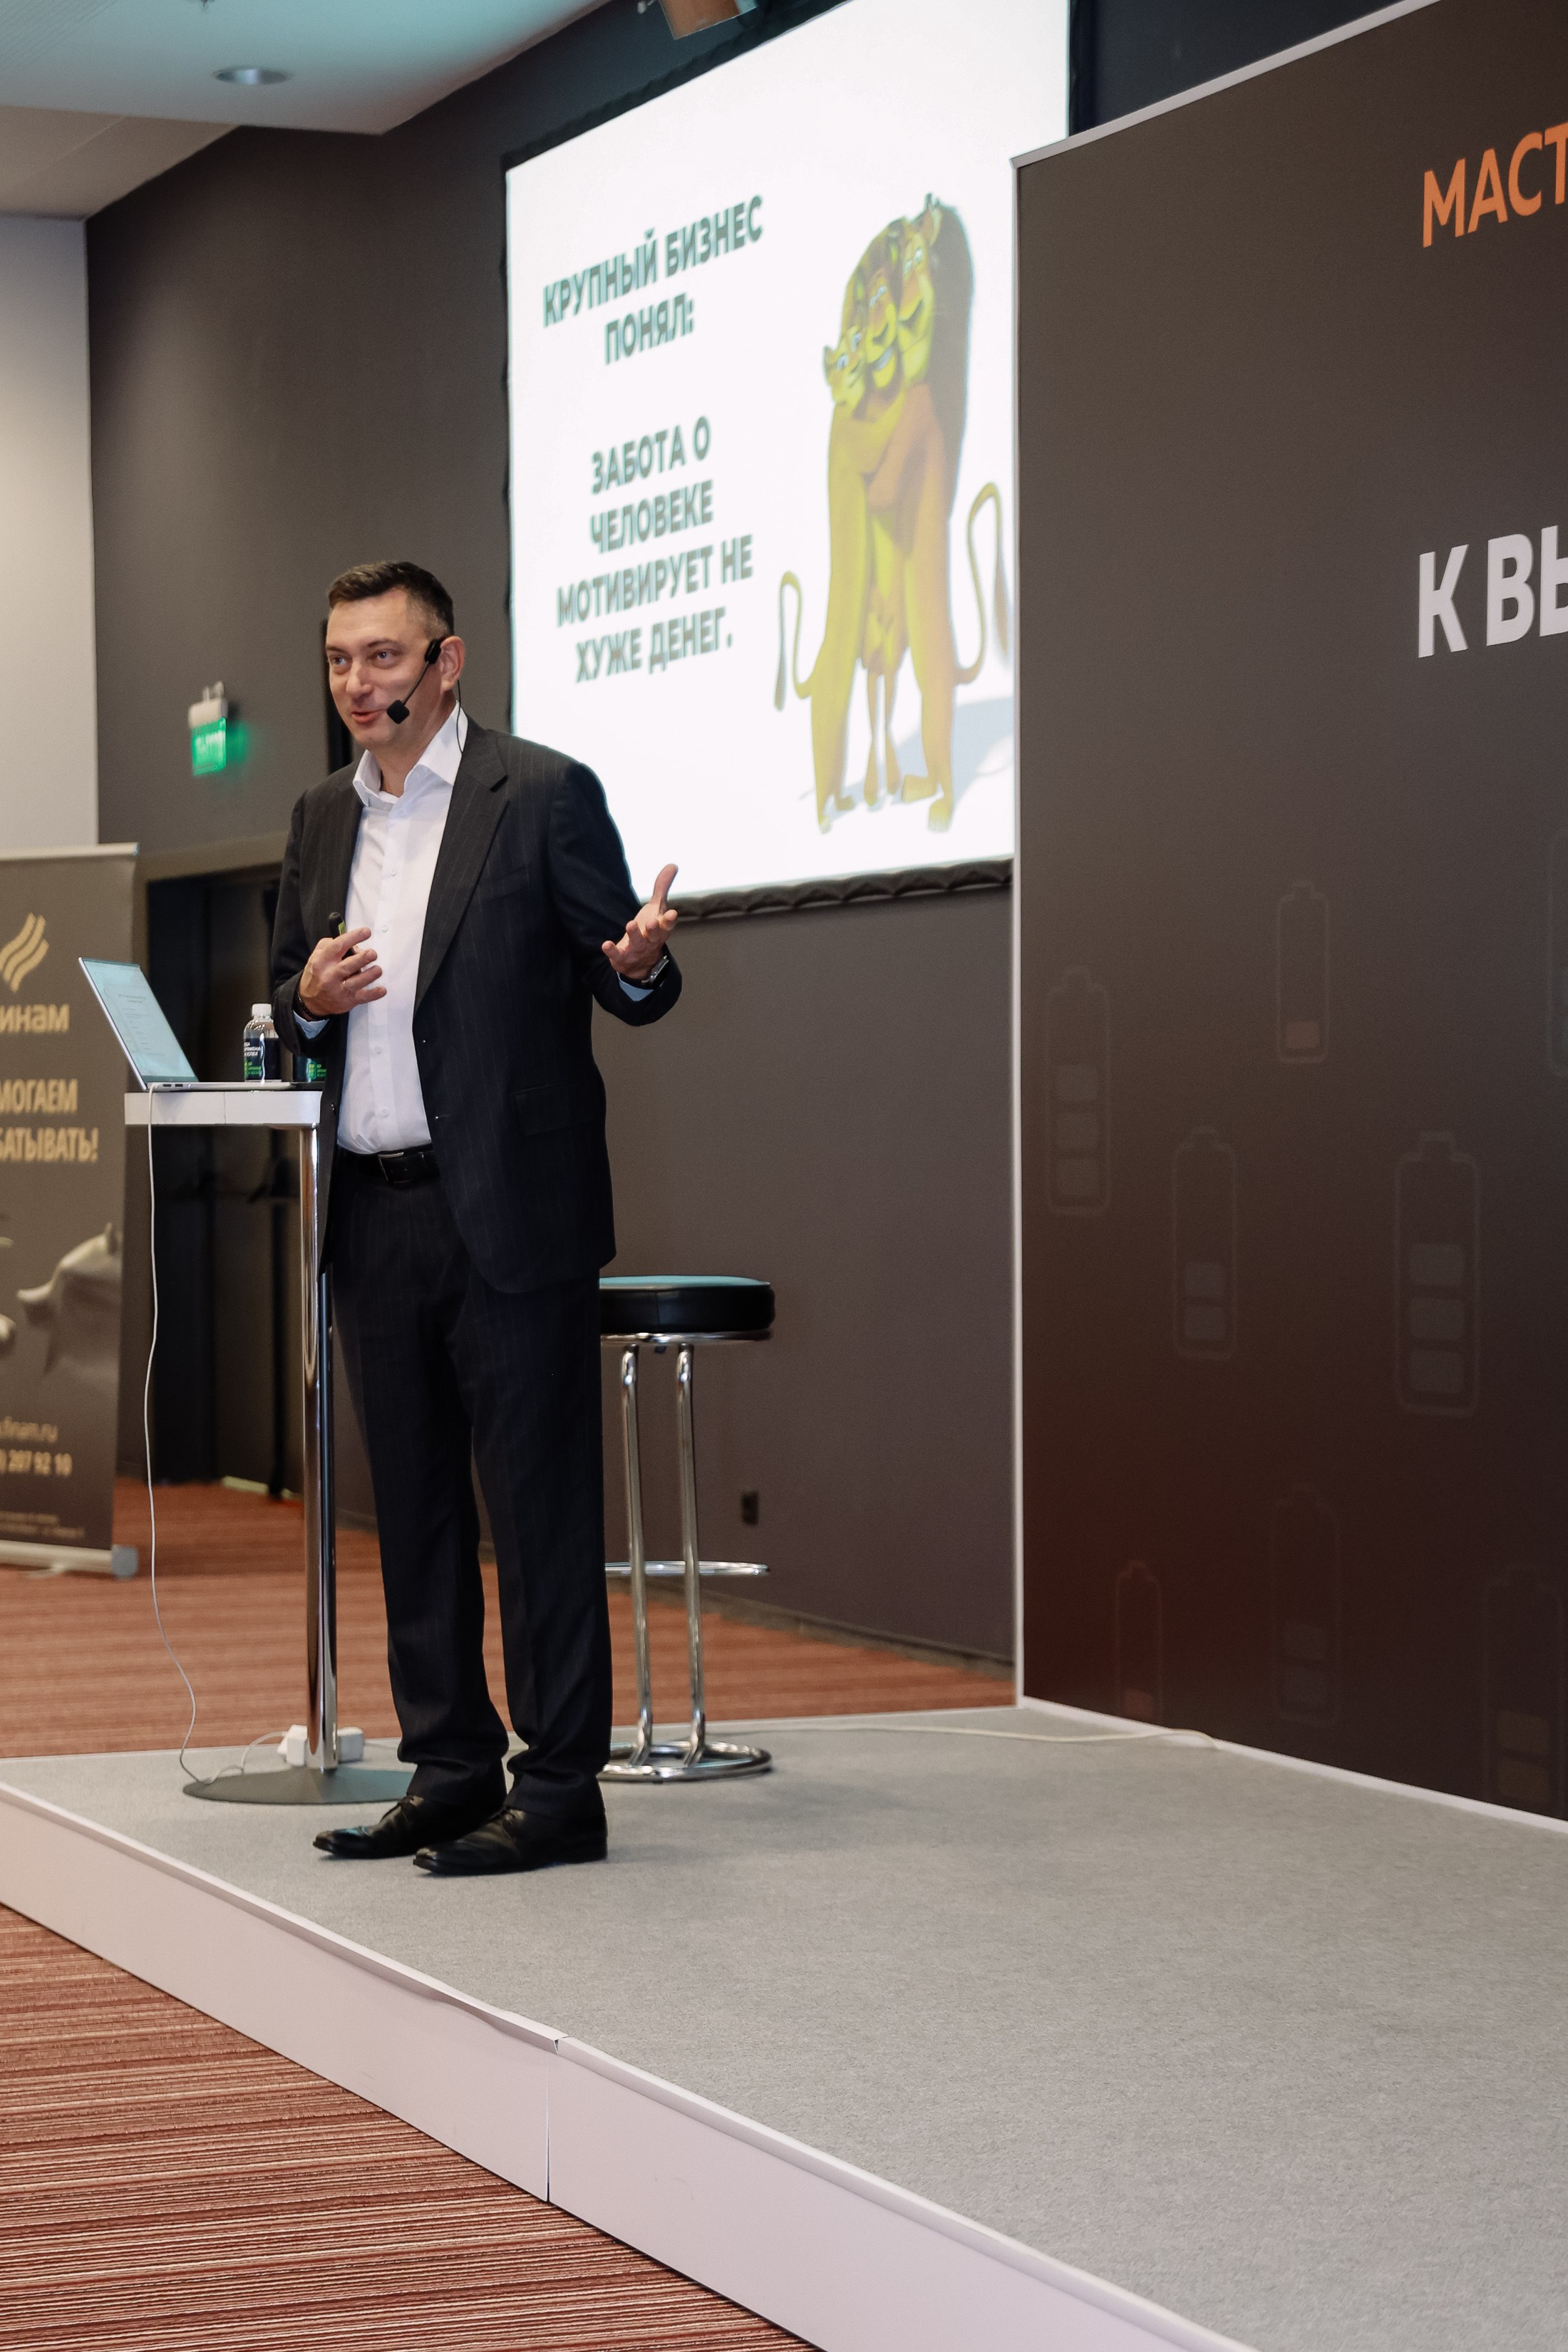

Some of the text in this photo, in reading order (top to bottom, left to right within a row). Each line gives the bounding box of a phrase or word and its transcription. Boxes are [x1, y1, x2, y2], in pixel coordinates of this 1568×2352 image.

[1423, 121, 1568, 248] МАСТ
[543, 195, 763, 328] КРУПНЫЙ БИЗНЕС
[604, 292, 694, 366] ПОНЯЛ:
[591, 416, 711, 496] ЗАБОТА О
[589, 479, 713, 555] ЧЕЛОВЕКЕ
[557, 533, 753, 628] МОТИВИРУЕТ НЕ
[1418, 544, 1470, 659] К
[576, 606, 733, 684] ХУЖЕ ДЕНЕГ.
